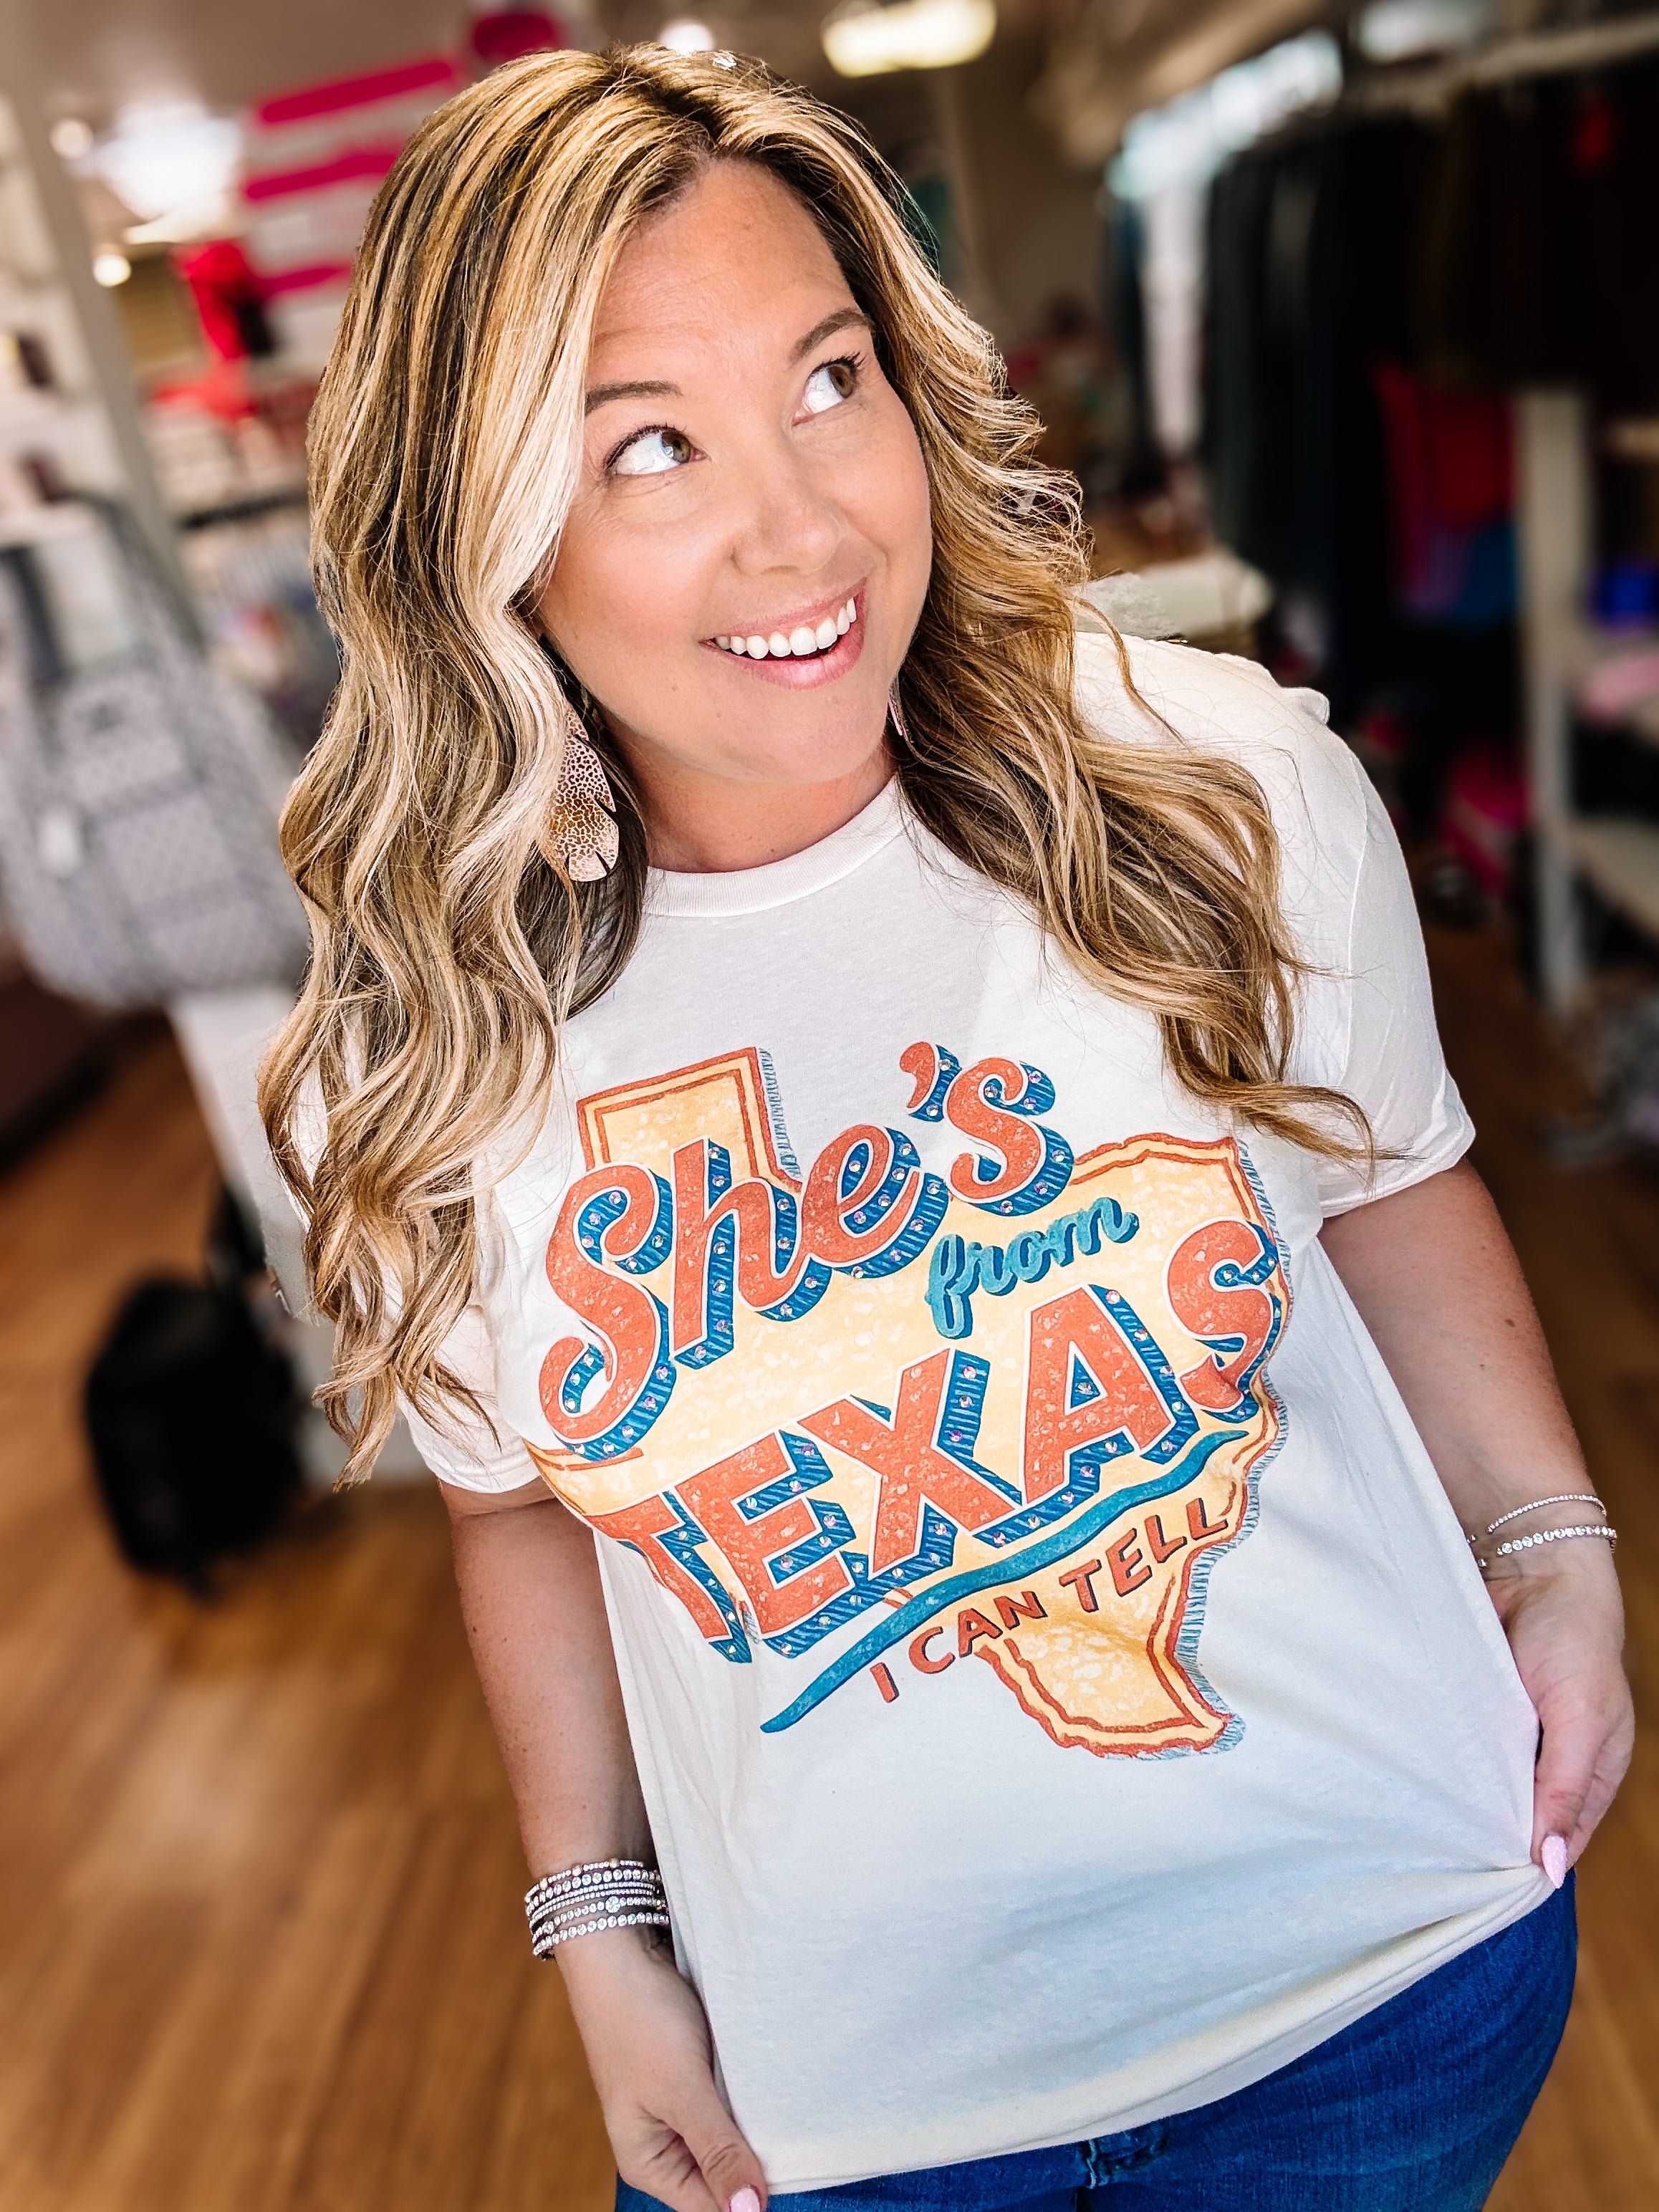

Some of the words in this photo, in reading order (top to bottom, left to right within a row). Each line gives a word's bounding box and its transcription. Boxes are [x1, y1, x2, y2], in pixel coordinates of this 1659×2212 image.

[538, 1041, 1075, 1461] She's
[925, 1197, 1139, 1339] from
[589, 1219, 1287, 1663] TEXAS
[870, 1661, 900, 1703] I
[908, 1590, 1047, 1674] CAN
[1059, 1496, 1229, 1614] TELL
